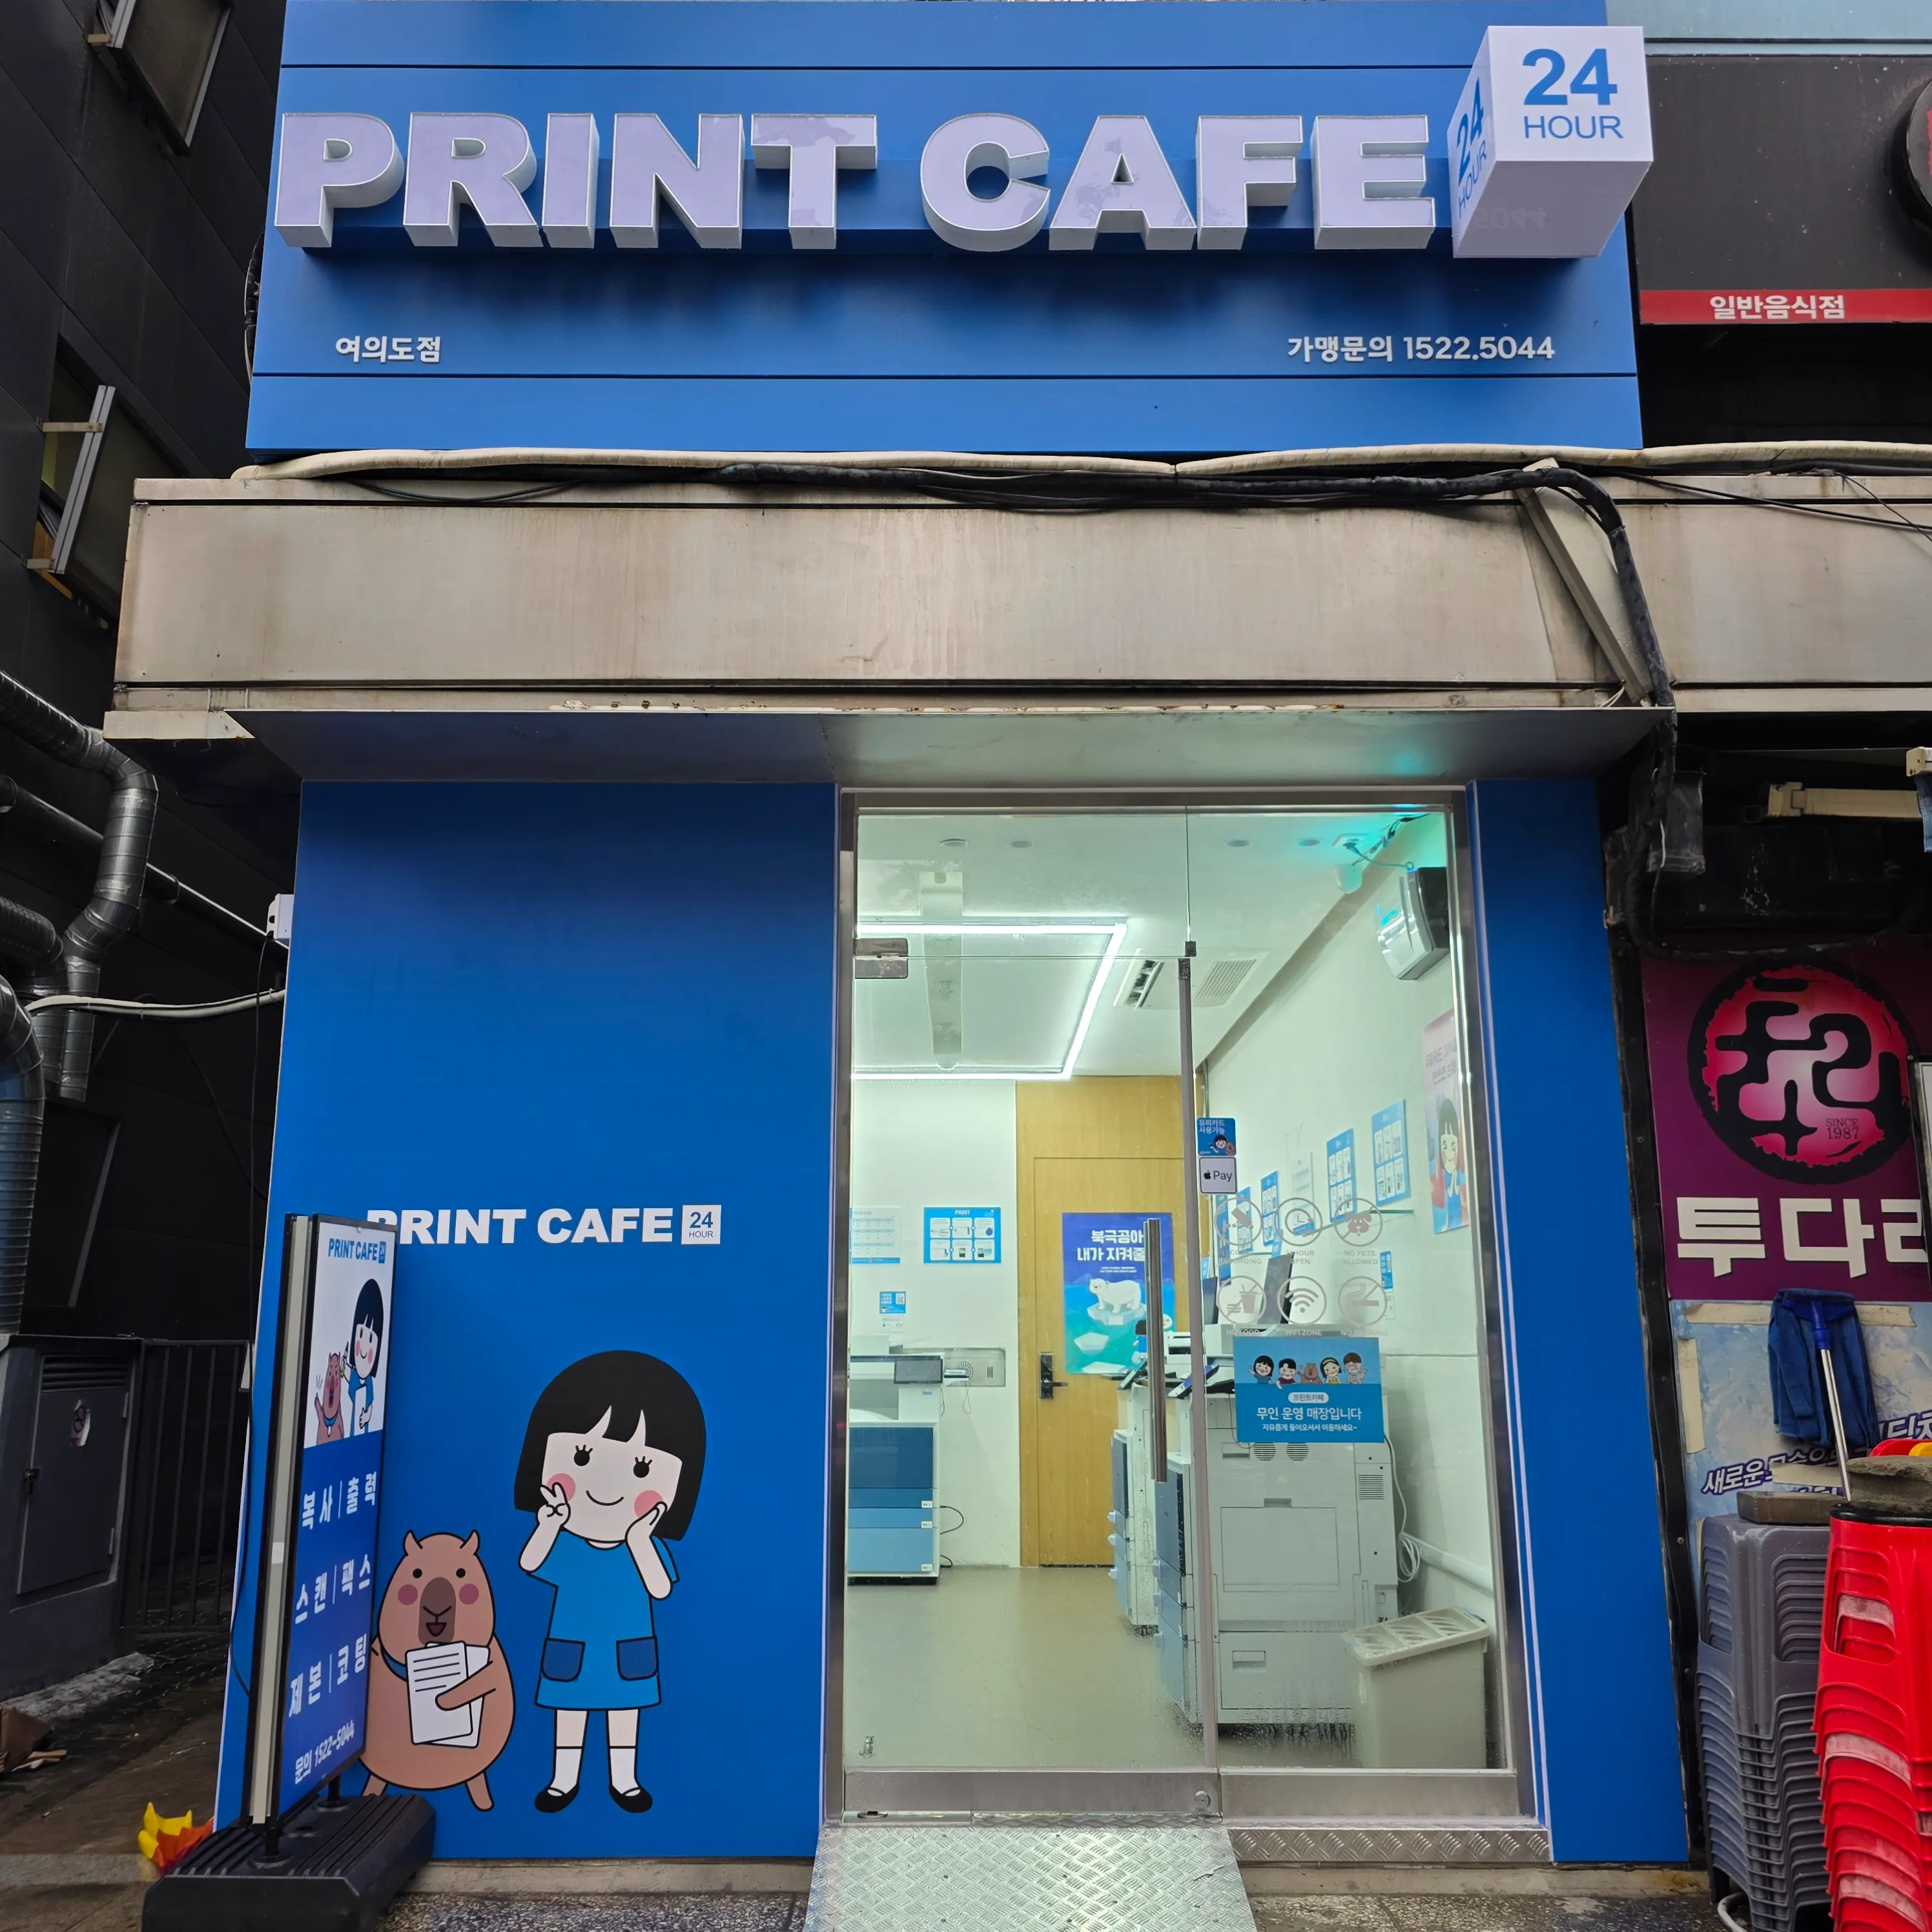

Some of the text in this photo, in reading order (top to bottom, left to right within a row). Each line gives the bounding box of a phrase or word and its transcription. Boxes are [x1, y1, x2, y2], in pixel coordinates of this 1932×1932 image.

[1523, 48, 1618, 105] 24
[1456, 77, 1484, 187] 24
[1523, 116, 1623, 139] HOUR
[274, 112, 1435, 251] PRINT CAFE
[1458, 139, 1487, 219] HOUR
[1709, 294, 1845, 320] 일반음식점
[335, 335, 441, 364] 여의도점
[1288, 336, 1556, 364] 가맹문의 1522.5044
[1199, 1126, 1225, 1135] 사용가능
[1825, 1118, 1859, 1127] SINCE
[1826, 1127, 1860, 1140] 1987
[1213, 1170, 1232, 1182] Pay
[537, 1208, 673, 1244] CAFE
[690, 1211, 714, 1228] 24
[328, 1238, 355, 1259] PRINT
[355, 1241, 378, 1260] CAFE
[1077, 1247, 1104, 1261] 내가
[1293, 1393, 1324, 1401] 프린트카페
[1256, 1407, 1362, 1421] 무인 운영 매장입니다
[1262, 1423, 1288, 1432] 자유롭게
[1289, 1423, 1321, 1432] 들어오셔서
[1703, 1460, 1764, 1494] 새로운
[302, 1471, 377, 1530] 복사 출력
[295, 1554, 371, 1625] 스캔 팩스
[289, 1634, 367, 1718] 제본 코팅
[295, 1720, 355, 1785] 문의 1522-5044
